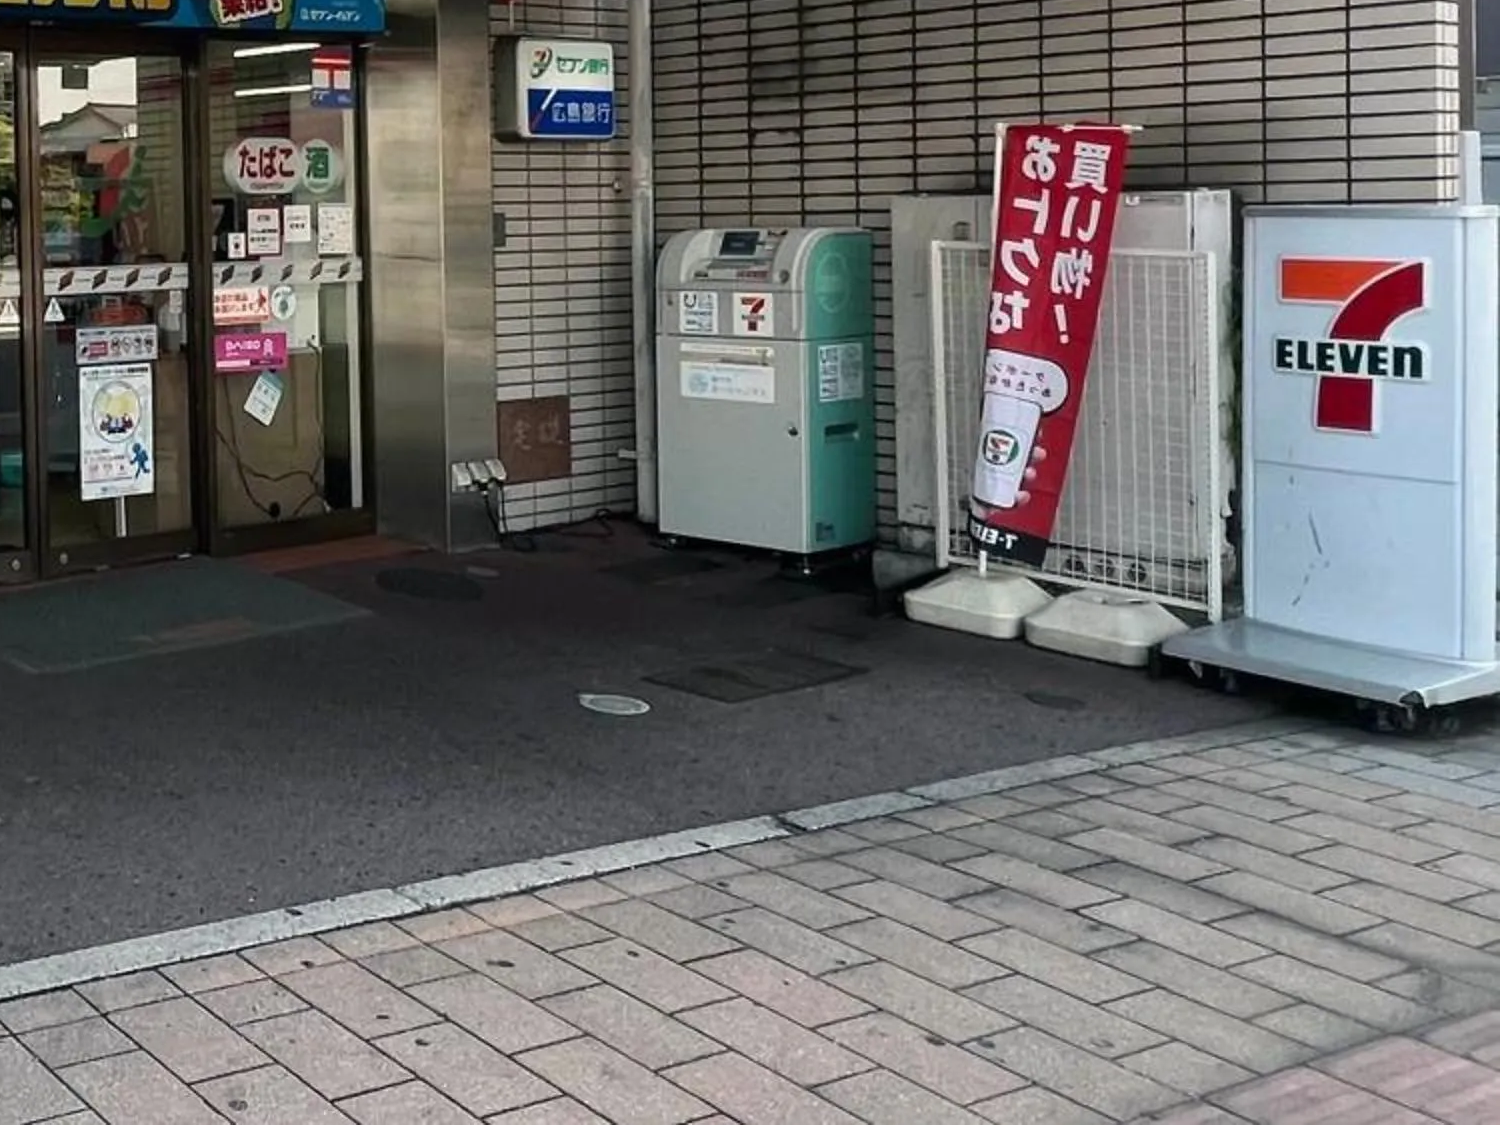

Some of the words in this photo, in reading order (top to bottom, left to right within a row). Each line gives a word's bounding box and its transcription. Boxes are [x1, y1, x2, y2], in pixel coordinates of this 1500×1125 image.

[238, 145, 295, 178] たばこ
[305, 146, 329, 180] 酒
